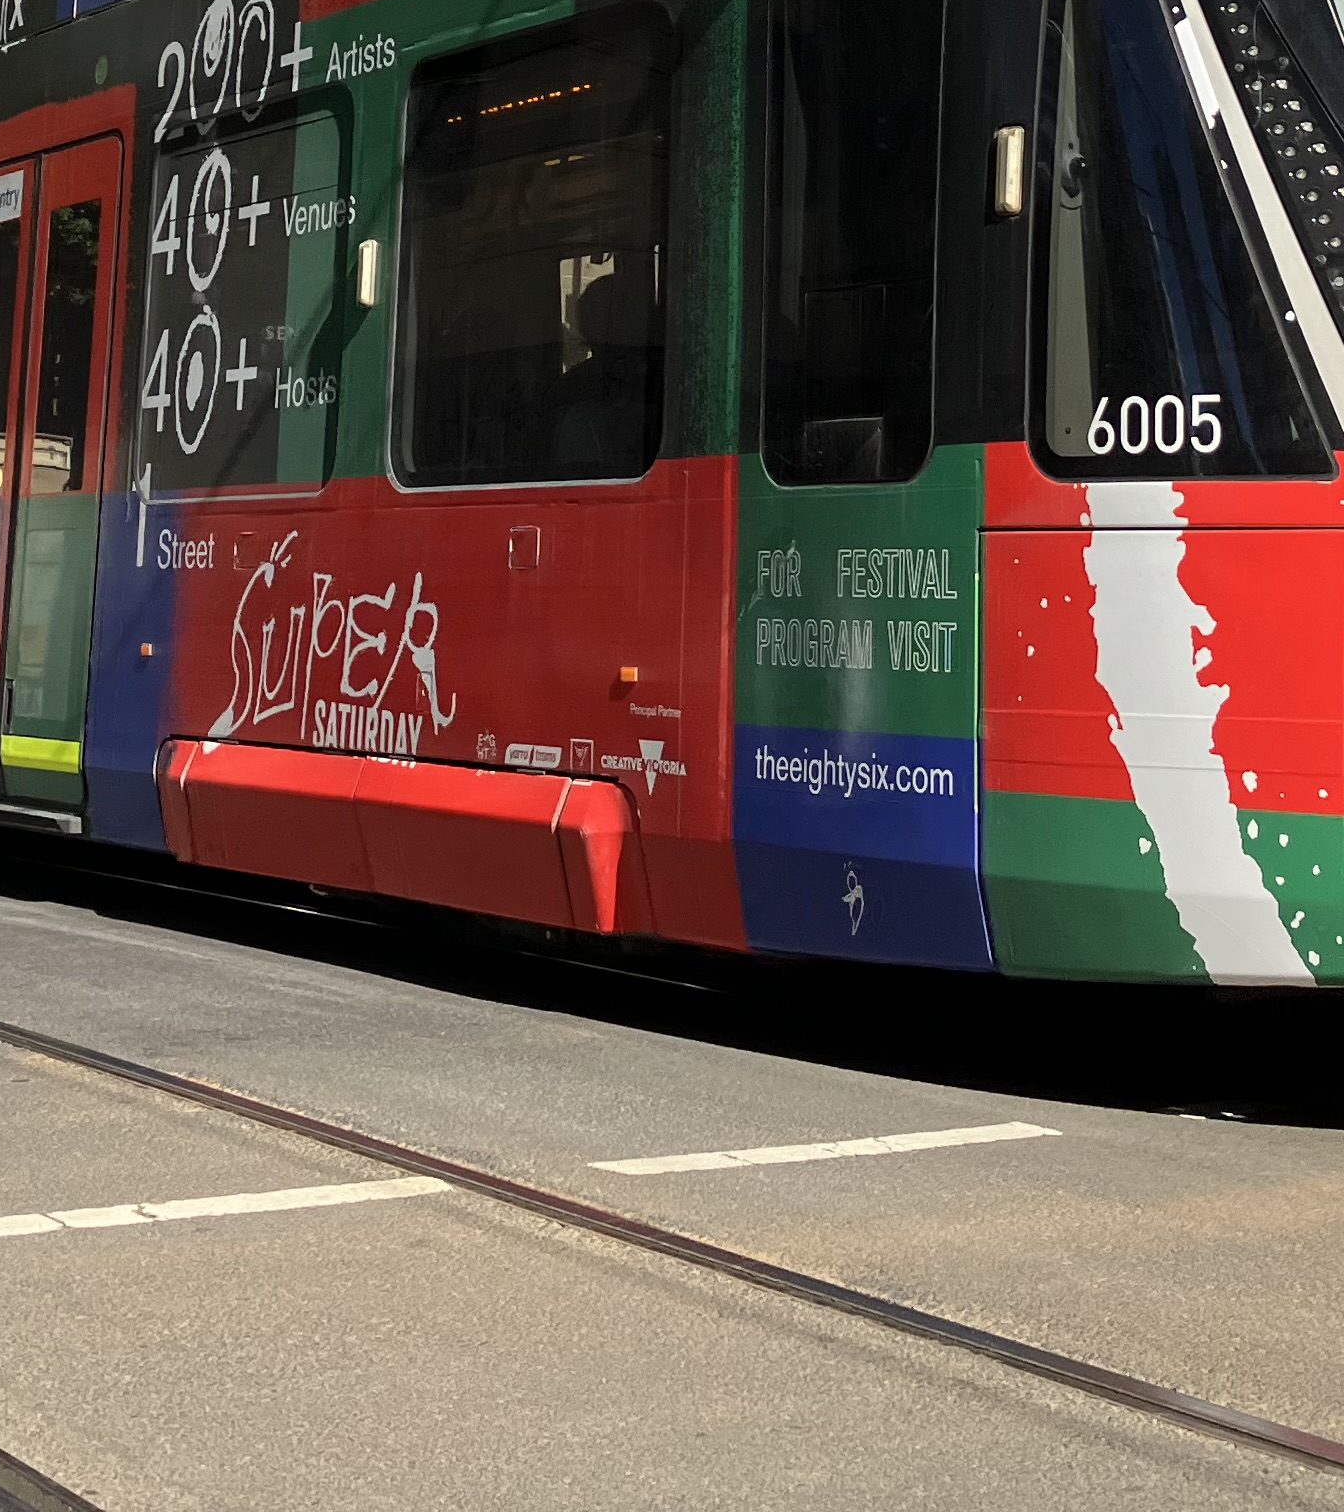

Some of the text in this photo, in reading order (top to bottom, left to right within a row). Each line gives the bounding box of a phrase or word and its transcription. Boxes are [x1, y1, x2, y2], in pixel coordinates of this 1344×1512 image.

[326, 34, 396, 83] Artists
[152, 142, 357, 292] 40+ Venues
[142, 306, 338, 455] 40+ Hosts
[1086, 394, 1223, 456] 6005
[131, 462, 216, 570] 1 Street
[757, 548, 958, 600] FOR FESTIVAL
[757, 619, 957, 672] PROGRAM VISIT
[312, 697, 424, 761] SATURDAY
[629, 702, 658, 719] Principal
[508, 749, 557, 763] yarra trams
[600, 754, 688, 777] CREATIVE VICTORIA
[754, 744, 954, 799] theeightysix.com
